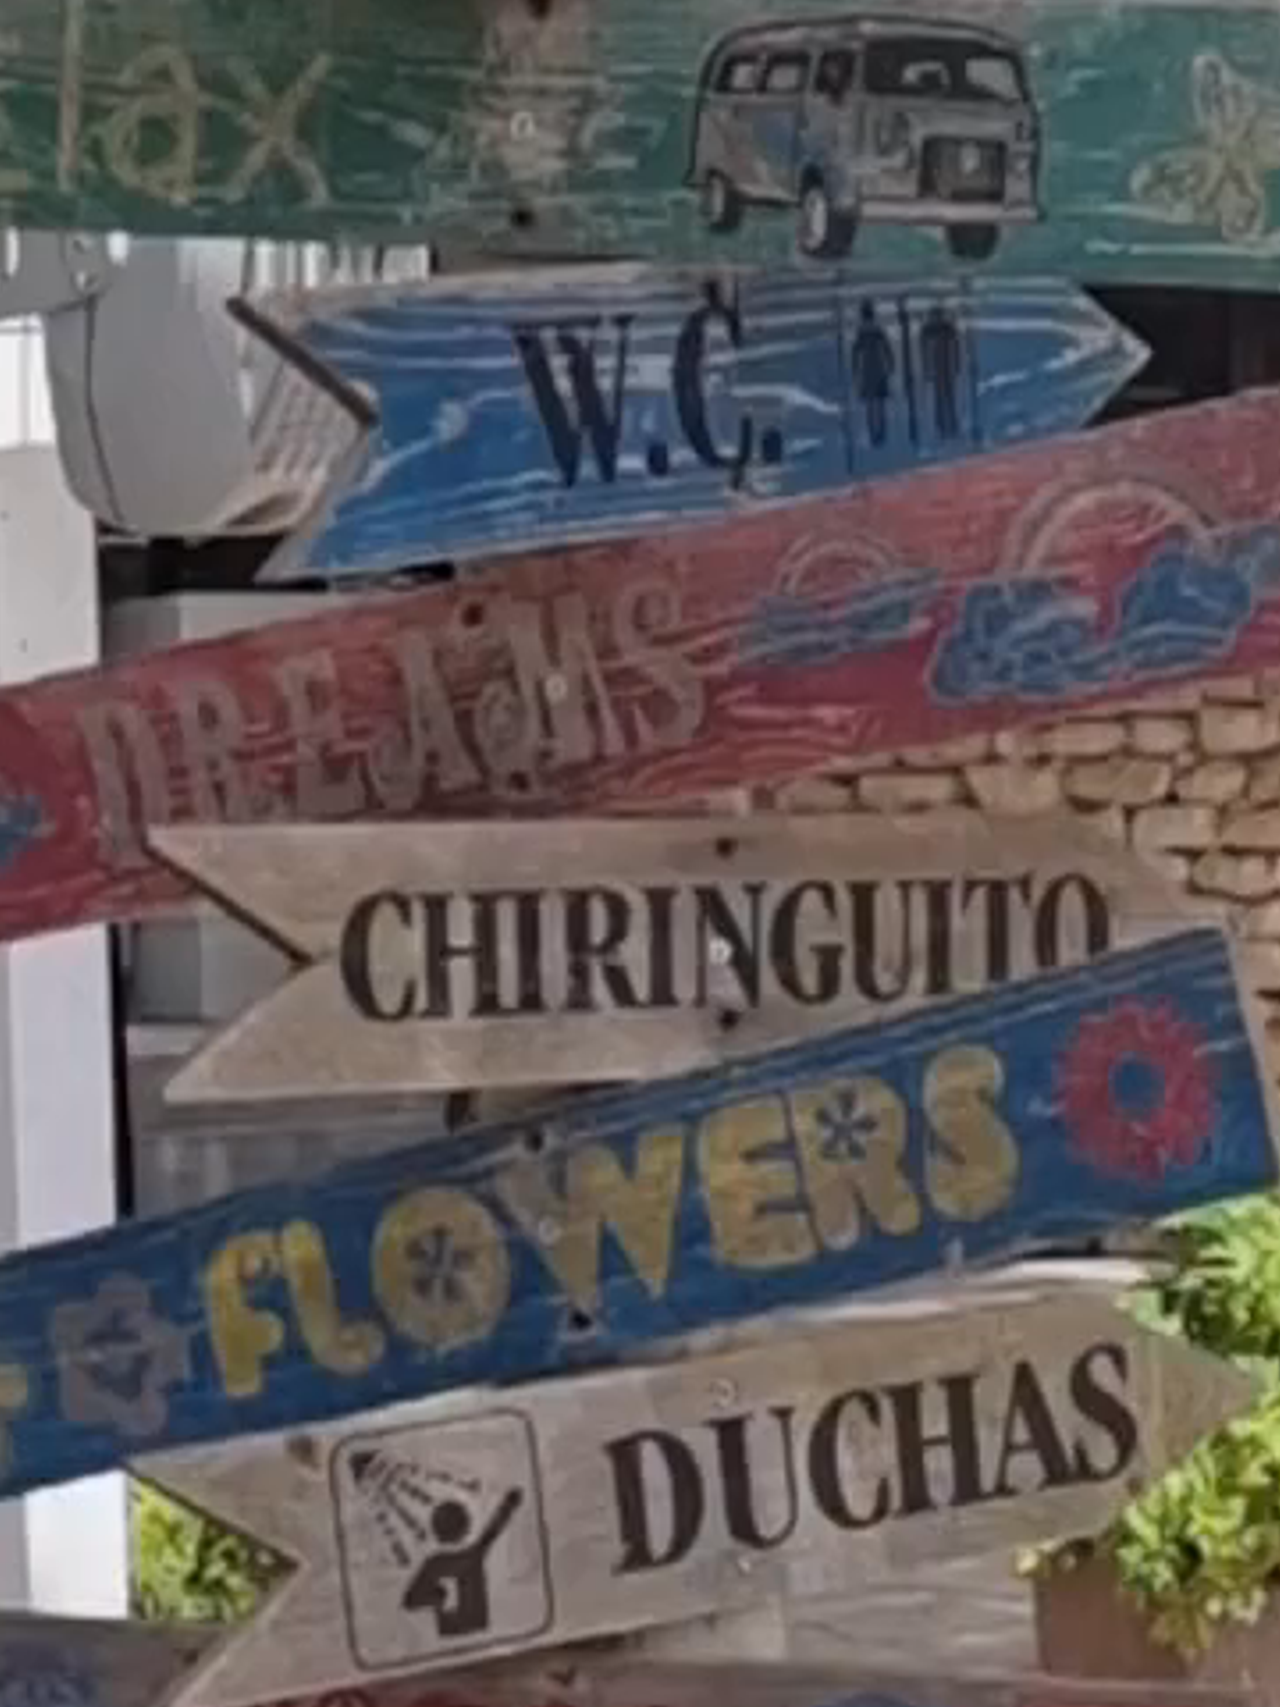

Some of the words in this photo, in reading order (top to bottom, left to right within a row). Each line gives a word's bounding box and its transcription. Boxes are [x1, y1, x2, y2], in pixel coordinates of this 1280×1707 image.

[515, 301, 784, 489] W.C.
[339, 872, 1111, 1024] CHIRINGUITO
[202, 1043, 1018, 1398] FLOWERS
[603, 1341, 1140, 1576] DUCHAS
